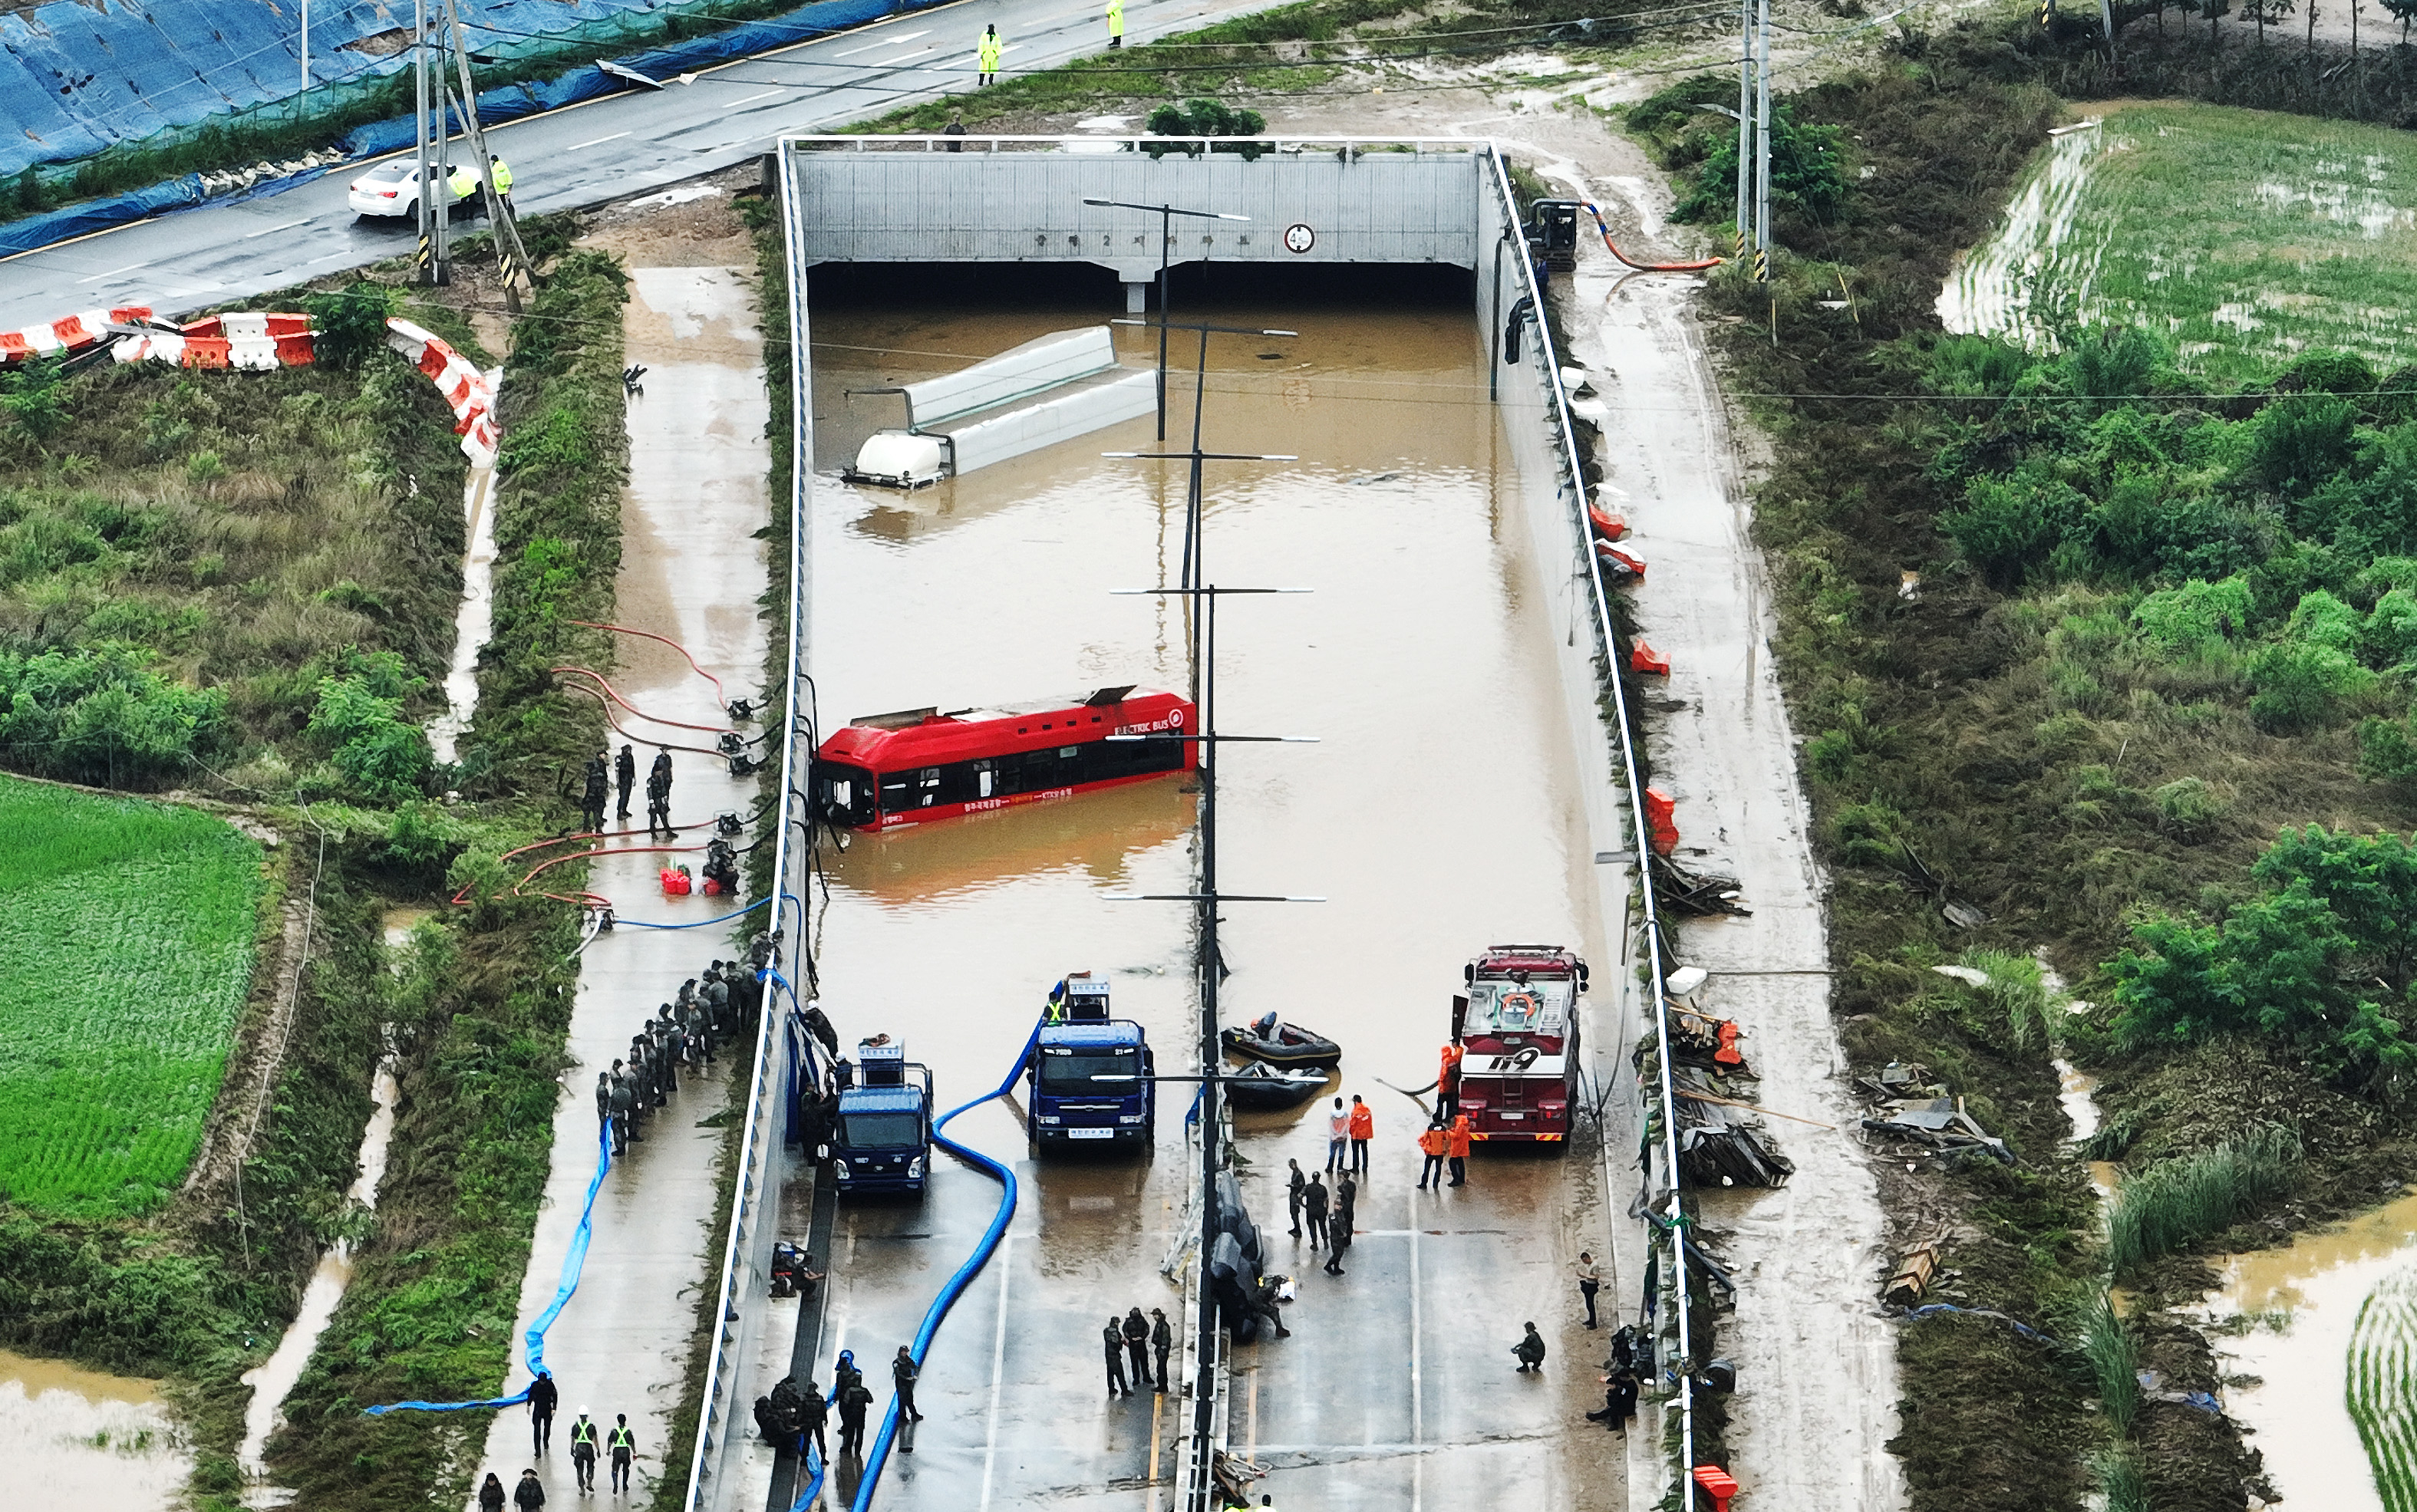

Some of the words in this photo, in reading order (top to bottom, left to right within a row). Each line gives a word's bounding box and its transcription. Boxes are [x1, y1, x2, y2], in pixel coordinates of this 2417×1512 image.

[1115, 722, 1151, 735] ELECTRIC
[1152, 719, 1169, 731] BUS
[1488, 1047, 1540, 1072] 119
